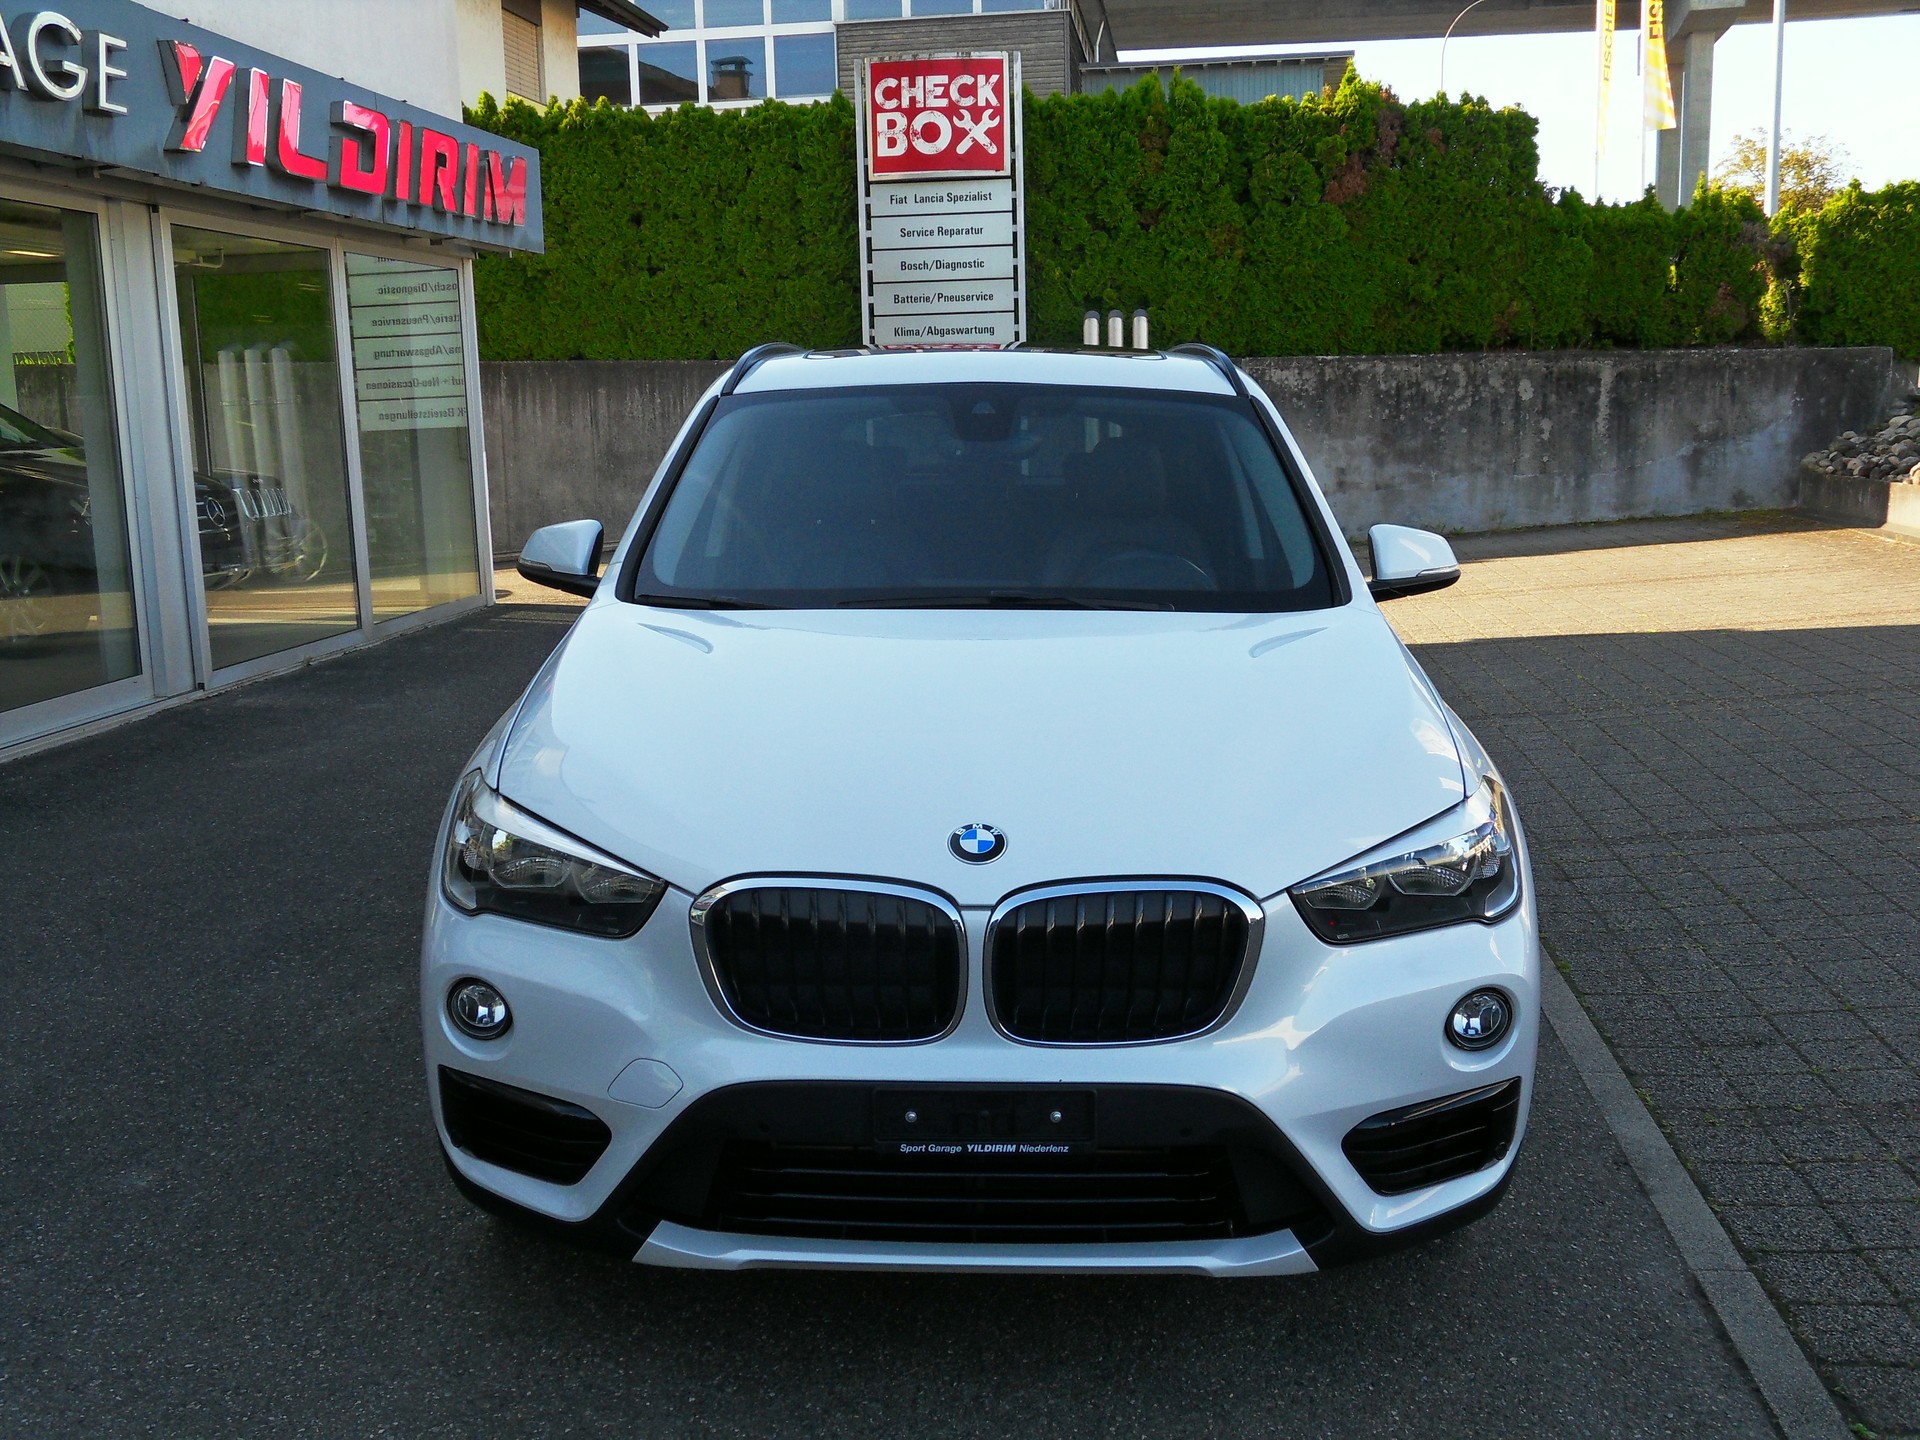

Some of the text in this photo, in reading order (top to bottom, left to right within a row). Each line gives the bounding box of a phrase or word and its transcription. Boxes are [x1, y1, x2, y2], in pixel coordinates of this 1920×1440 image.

[1648, 0, 1663, 40] FIS
[1603, 0, 1614, 83] FISCHE
[874, 74, 1000, 110] CHECK
[158, 38, 527, 227] YILDIRIM
[889, 191, 993, 205] Fiat Lancia Spezialist
[900, 226, 984, 238] Service Reparatur
[900, 258, 985, 272] Bosch/Diagnostic
[893, 292, 994, 305] Batterie/Pneuservice
[894, 325, 995, 338] Klima/Abgaswartung
[955, 823, 1002, 835] BMW
[900, 1144, 1069, 1154] Sport Garage YILDIRIM Niederlenz
